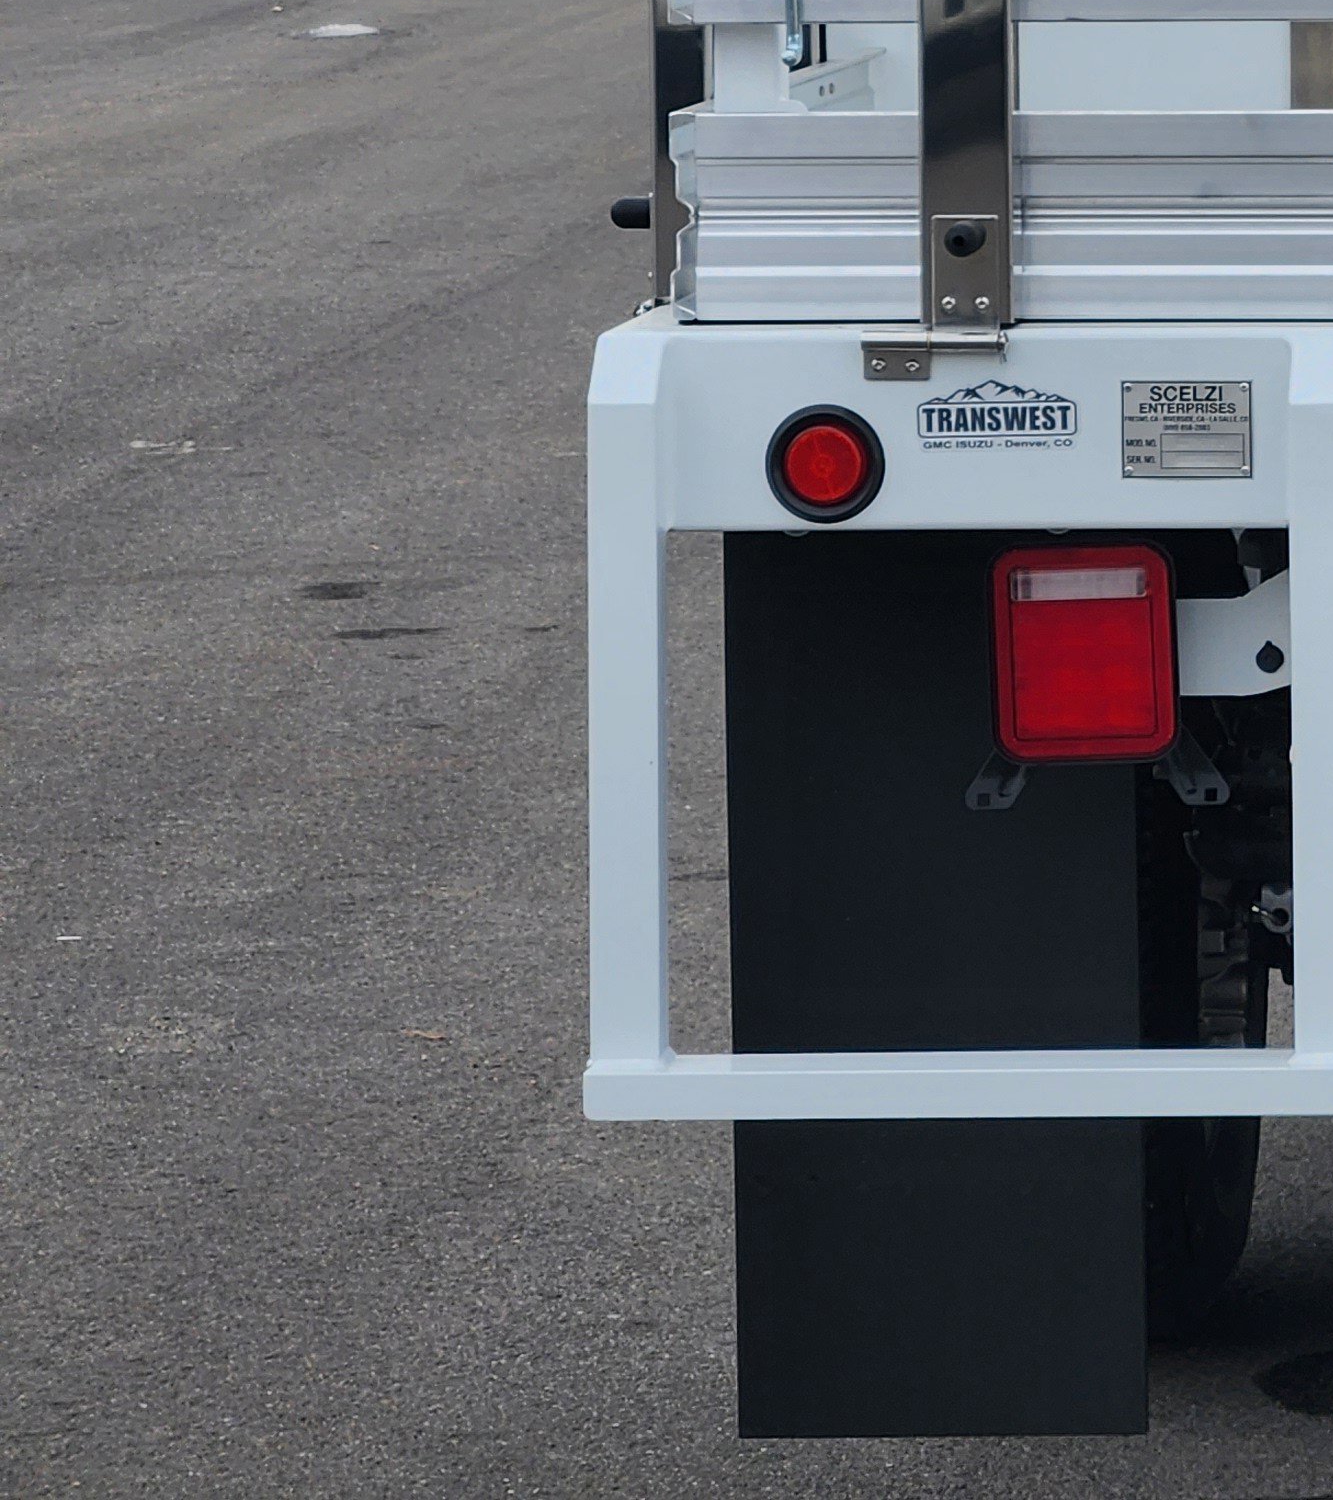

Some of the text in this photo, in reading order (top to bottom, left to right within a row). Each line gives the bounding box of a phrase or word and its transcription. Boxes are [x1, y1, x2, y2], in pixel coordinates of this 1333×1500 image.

[1149, 385, 1223, 402] SCELZI
[1138, 402, 1237, 414] ENTERPRISES
[921, 405, 1071, 433] TRANSWEST
[922, 440, 953, 449] GMC
[955, 440, 994, 449] ISUZU
[1005, 439, 1051, 449] Denver,
[1053, 438, 1073, 448] CO
